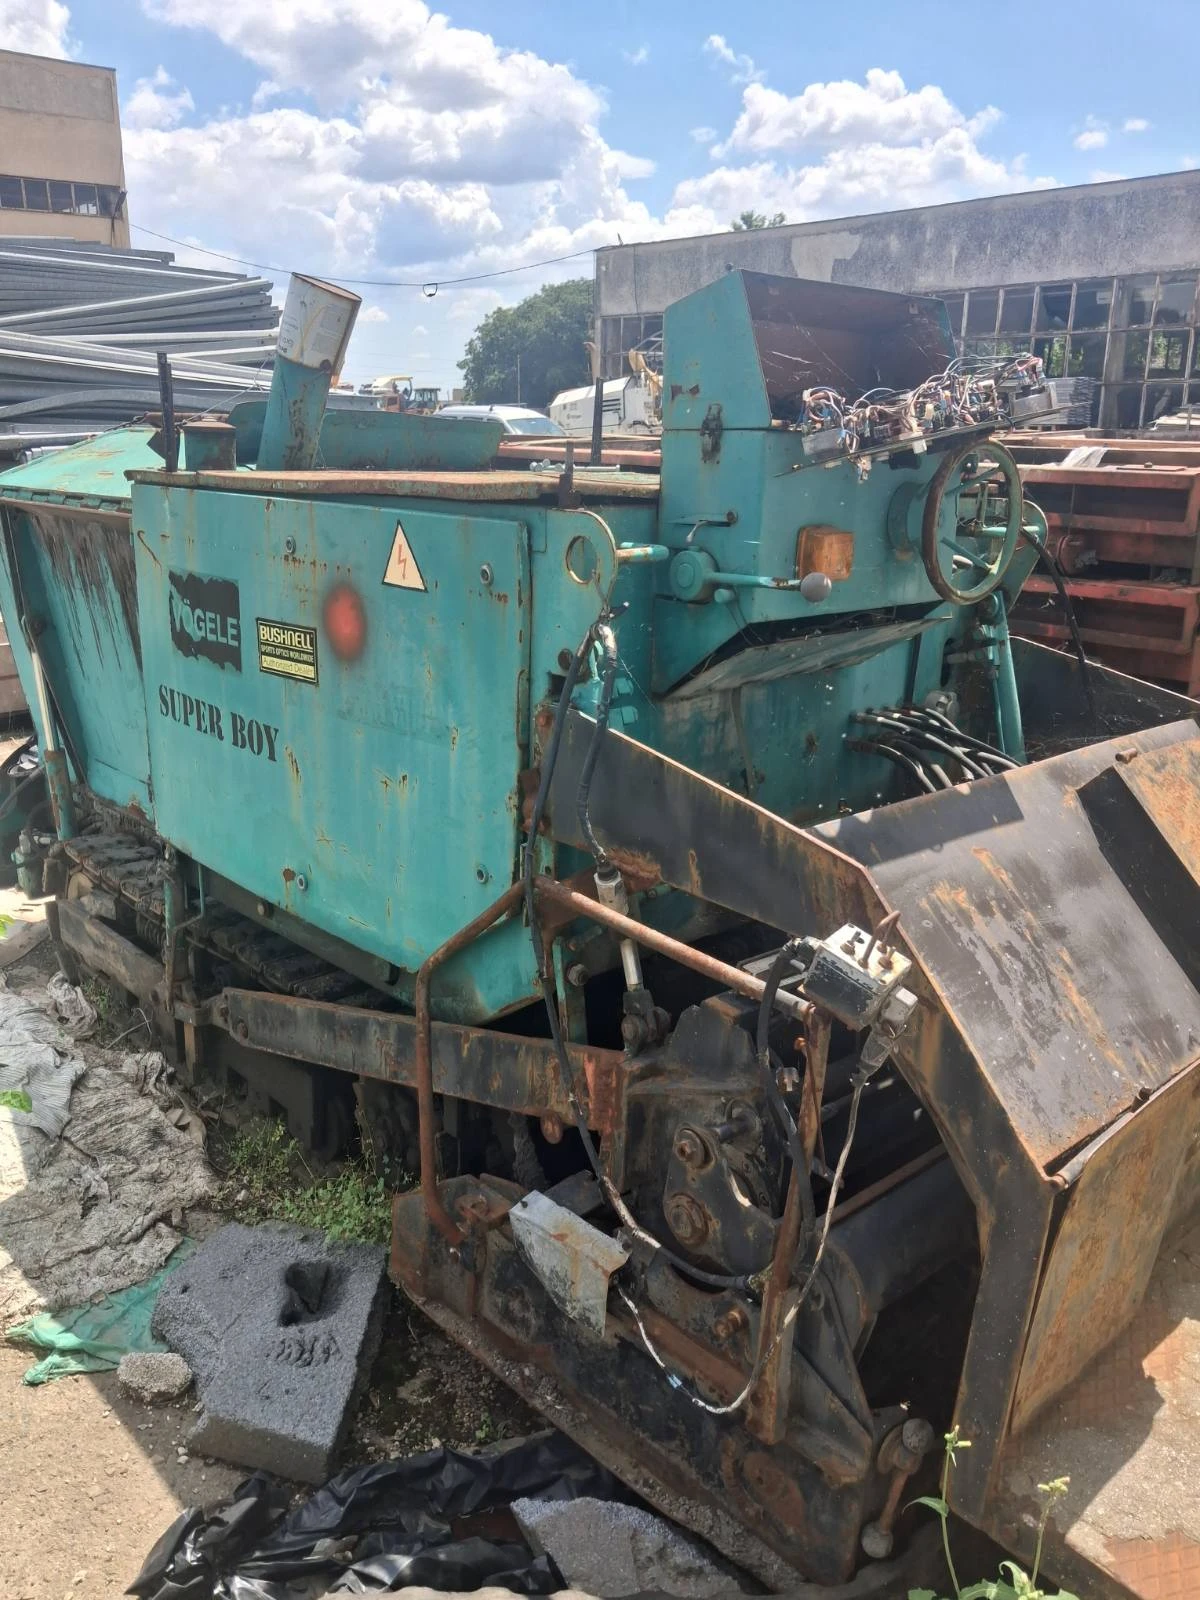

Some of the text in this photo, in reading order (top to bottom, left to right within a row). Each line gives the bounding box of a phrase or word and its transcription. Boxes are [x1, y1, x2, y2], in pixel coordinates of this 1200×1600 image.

[260, 625, 313, 650] BUSHNELL
[159, 684, 279, 762] SUPER BOY
